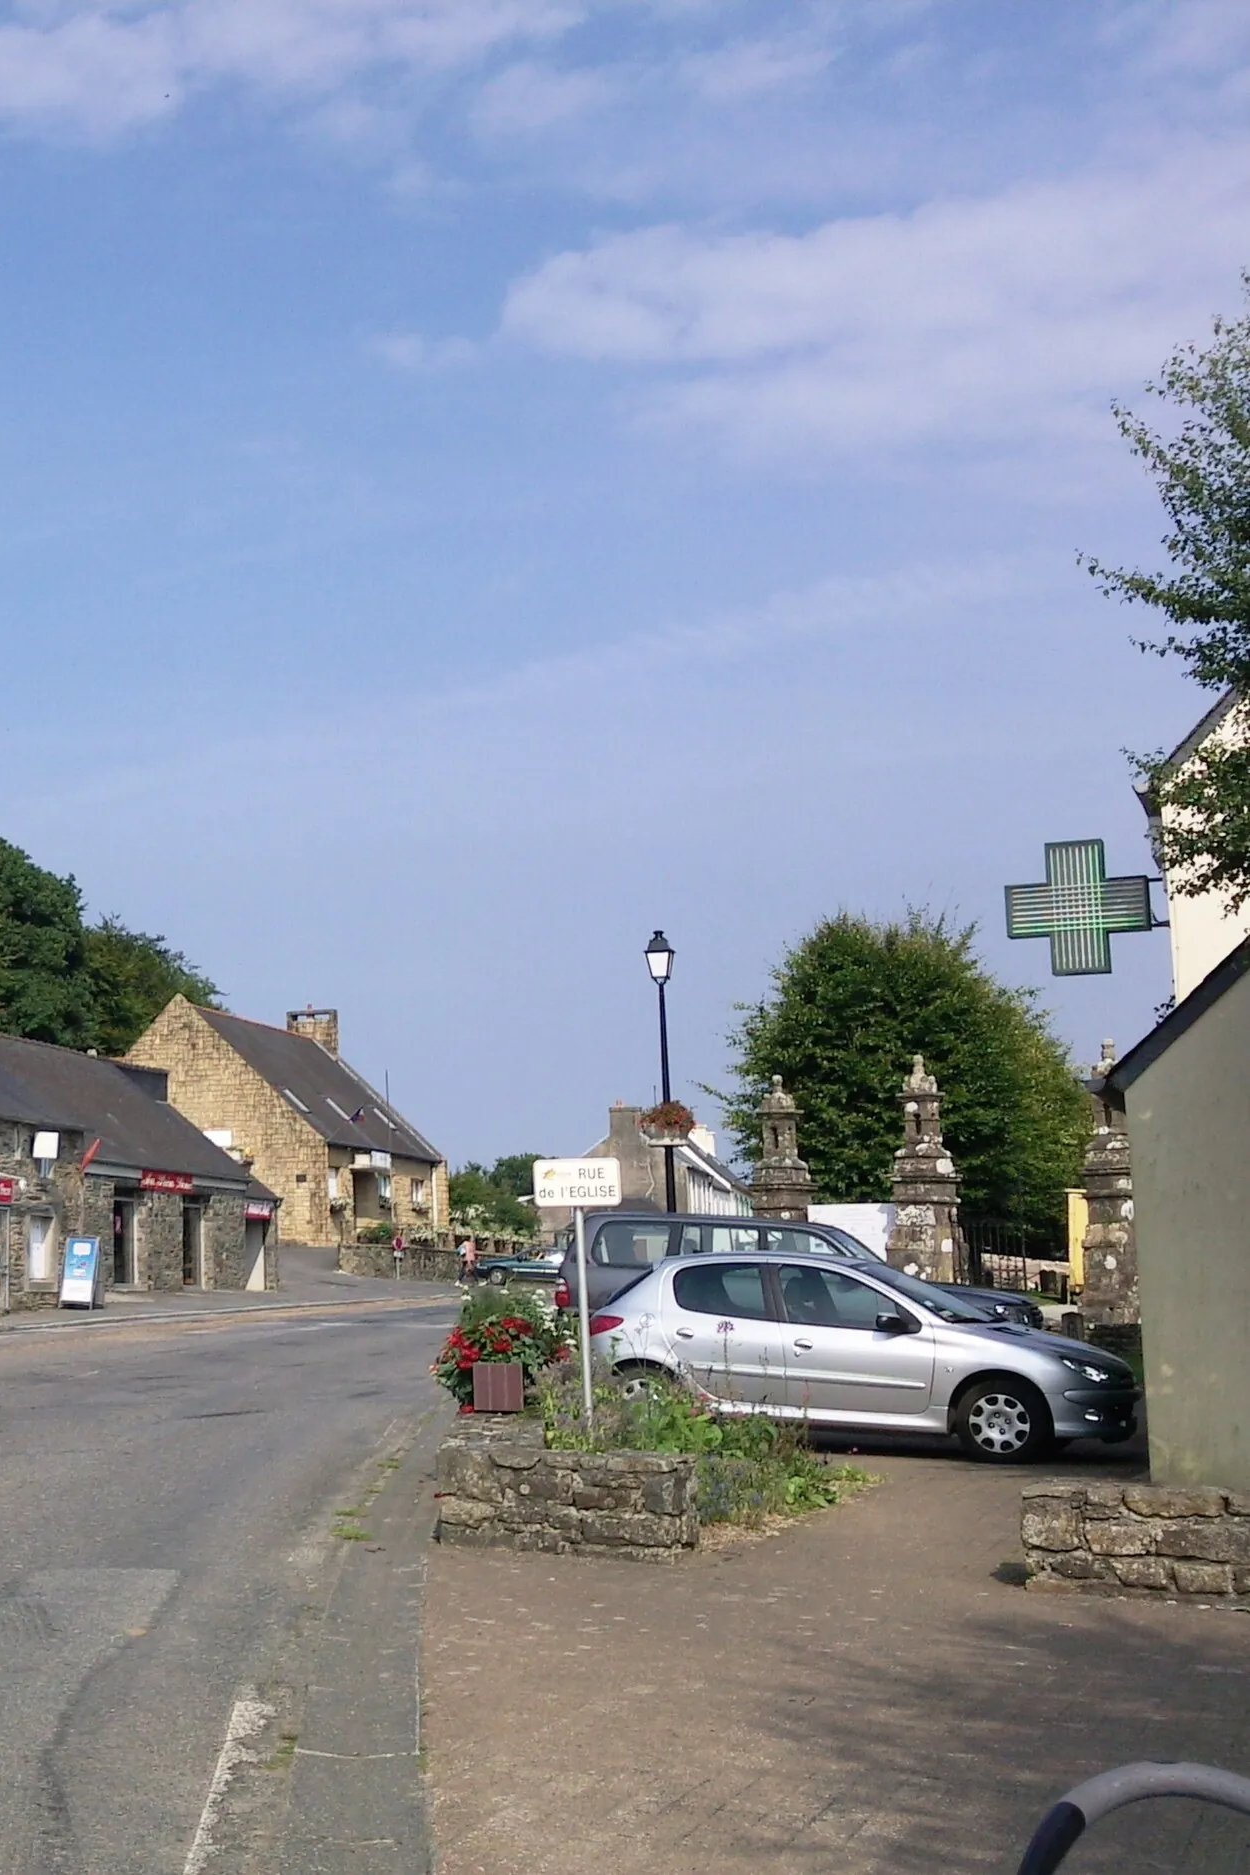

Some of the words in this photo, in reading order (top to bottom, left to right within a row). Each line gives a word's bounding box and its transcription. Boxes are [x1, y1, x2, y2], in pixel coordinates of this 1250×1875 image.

[578, 1167, 606, 1180] RUE
[538, 1187, 555, 1199] de
[560, 1185, 617, 1198] l'EGLISE
